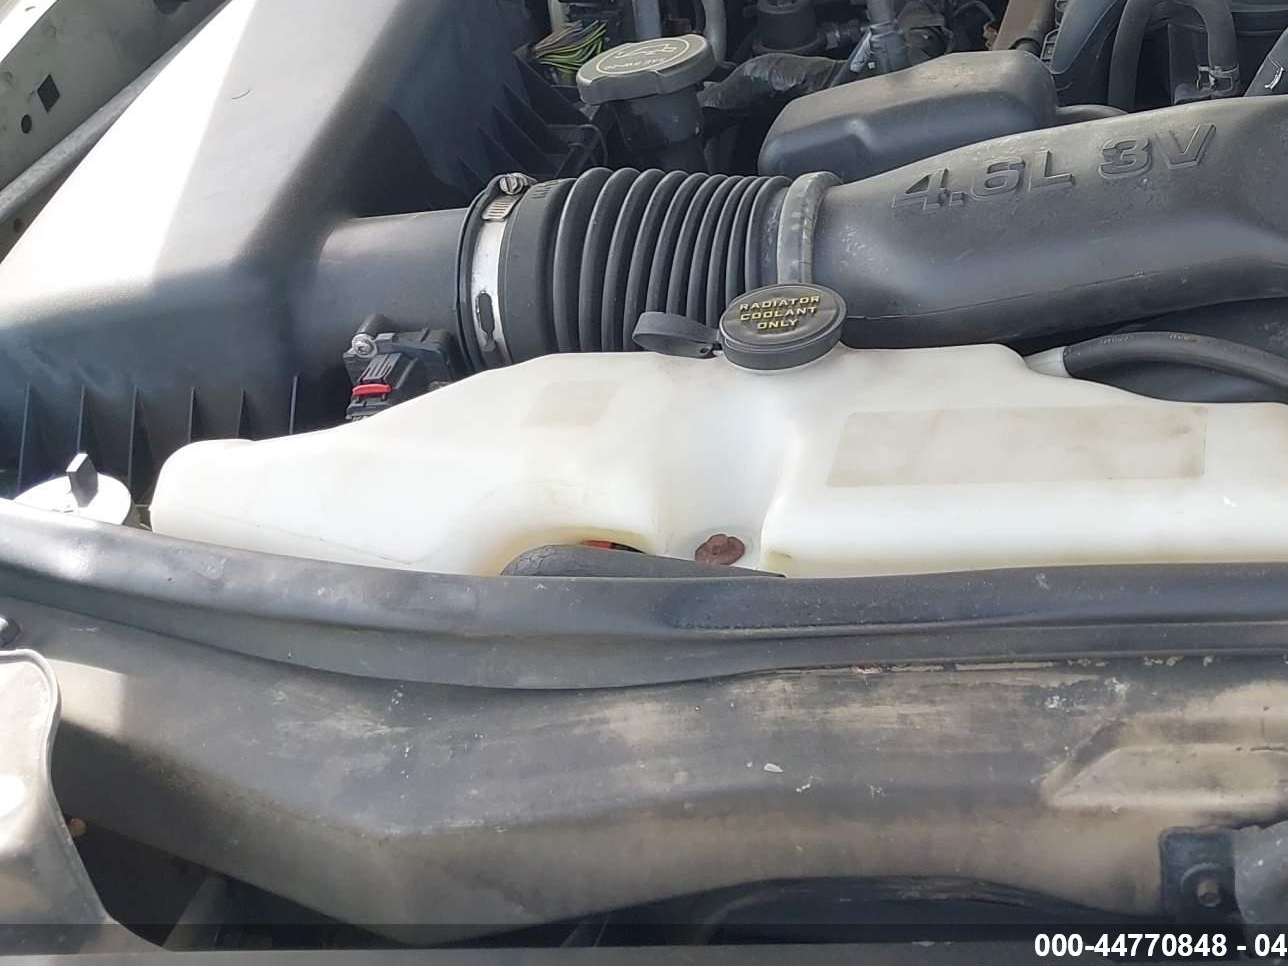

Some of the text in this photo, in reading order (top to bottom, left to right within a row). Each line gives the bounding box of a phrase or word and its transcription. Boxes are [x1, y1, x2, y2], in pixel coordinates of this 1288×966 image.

[892, 123, 1216, 210] 4.6L 3V
[740, 295, 820, 311] RADIATOR
[740, 306, 817, 321] COOLANT
[757, 318, 799, 330] ONLY
